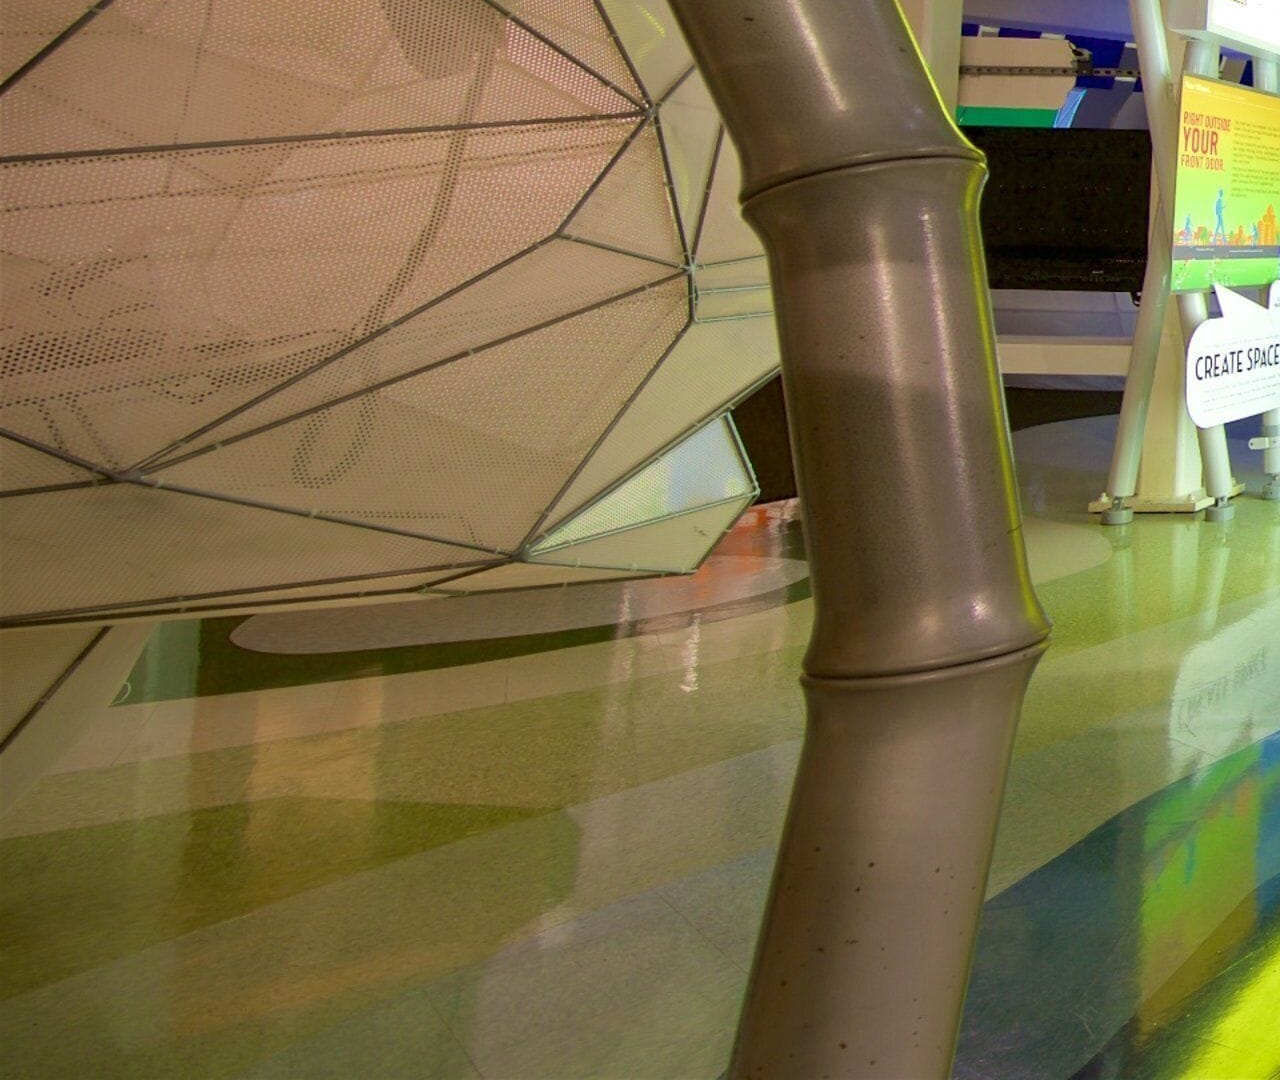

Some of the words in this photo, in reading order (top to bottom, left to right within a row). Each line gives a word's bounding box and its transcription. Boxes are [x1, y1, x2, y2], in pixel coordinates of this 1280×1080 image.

[1183, 111, 1203, 127] RIGHT
[1205, 116, 1231, 132] OUTSIDE
[1183, 127, 1218, 156] YOUR
[1181, 153, 1203, 170] FRONT
[1195, 350, 1243, 381] CREATE
